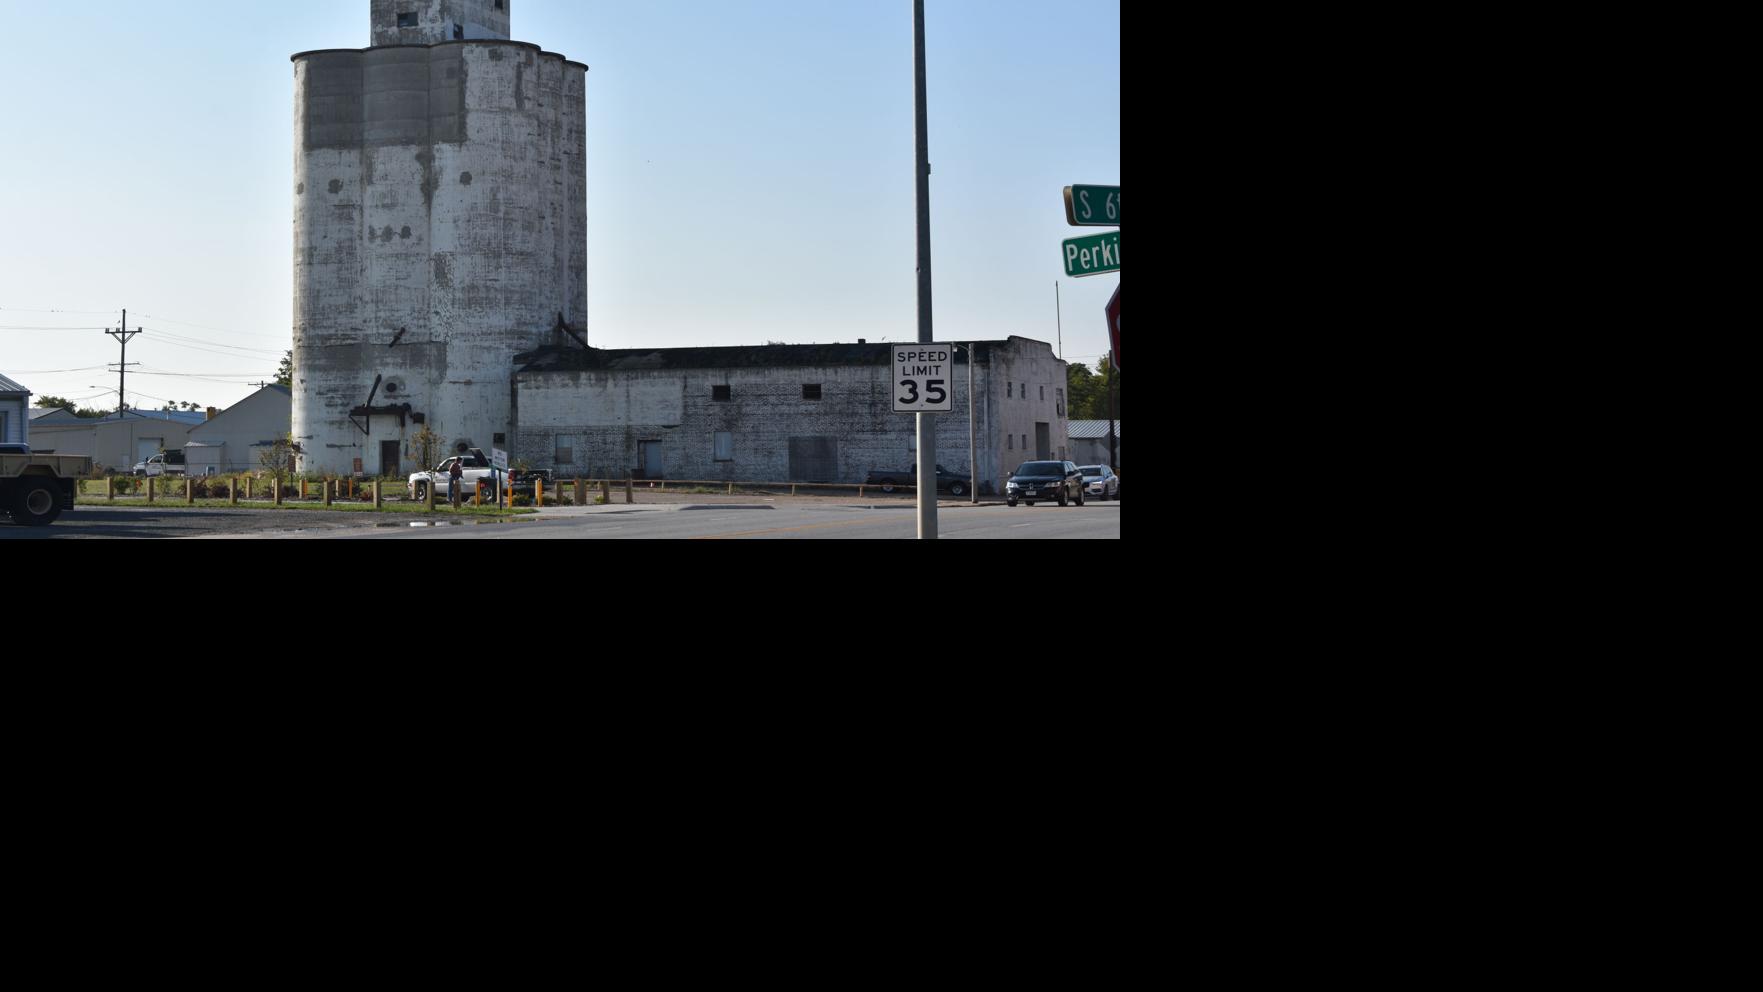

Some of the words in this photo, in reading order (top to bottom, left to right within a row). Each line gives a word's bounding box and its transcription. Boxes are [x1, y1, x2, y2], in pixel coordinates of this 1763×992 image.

[1080, 190, 1092, 219] S
[1066, 237, 1120, 272] Perki
[897, 351, 948, 362] SPEED
[902, 365, 941, 376] LIMIT
[898, 379, 947, 404] 35
